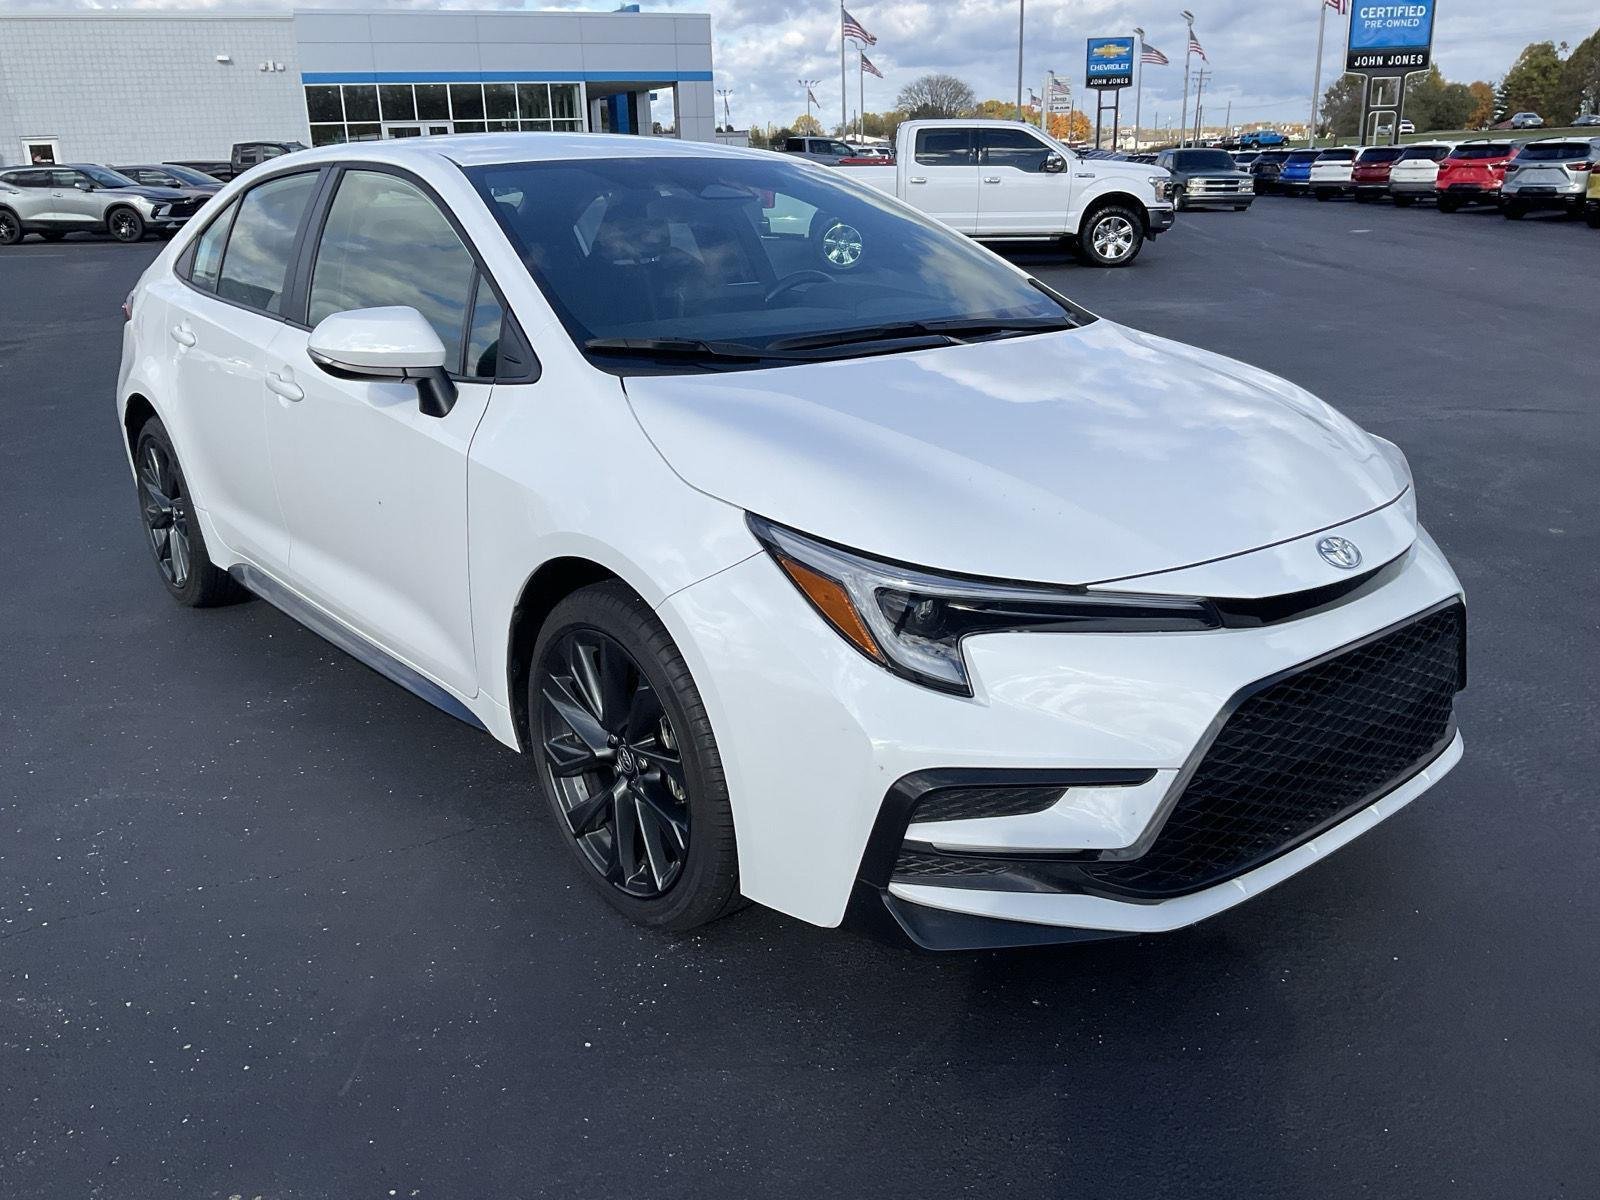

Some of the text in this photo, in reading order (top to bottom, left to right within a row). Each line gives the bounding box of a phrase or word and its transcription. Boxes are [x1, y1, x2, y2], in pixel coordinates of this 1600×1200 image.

[1361, 6, 1426, 18] CERTIFIED
[1365, 19, 1419, 28] PRE-OWNED
[1354, 55, 1423, 66] JOHN JONES
